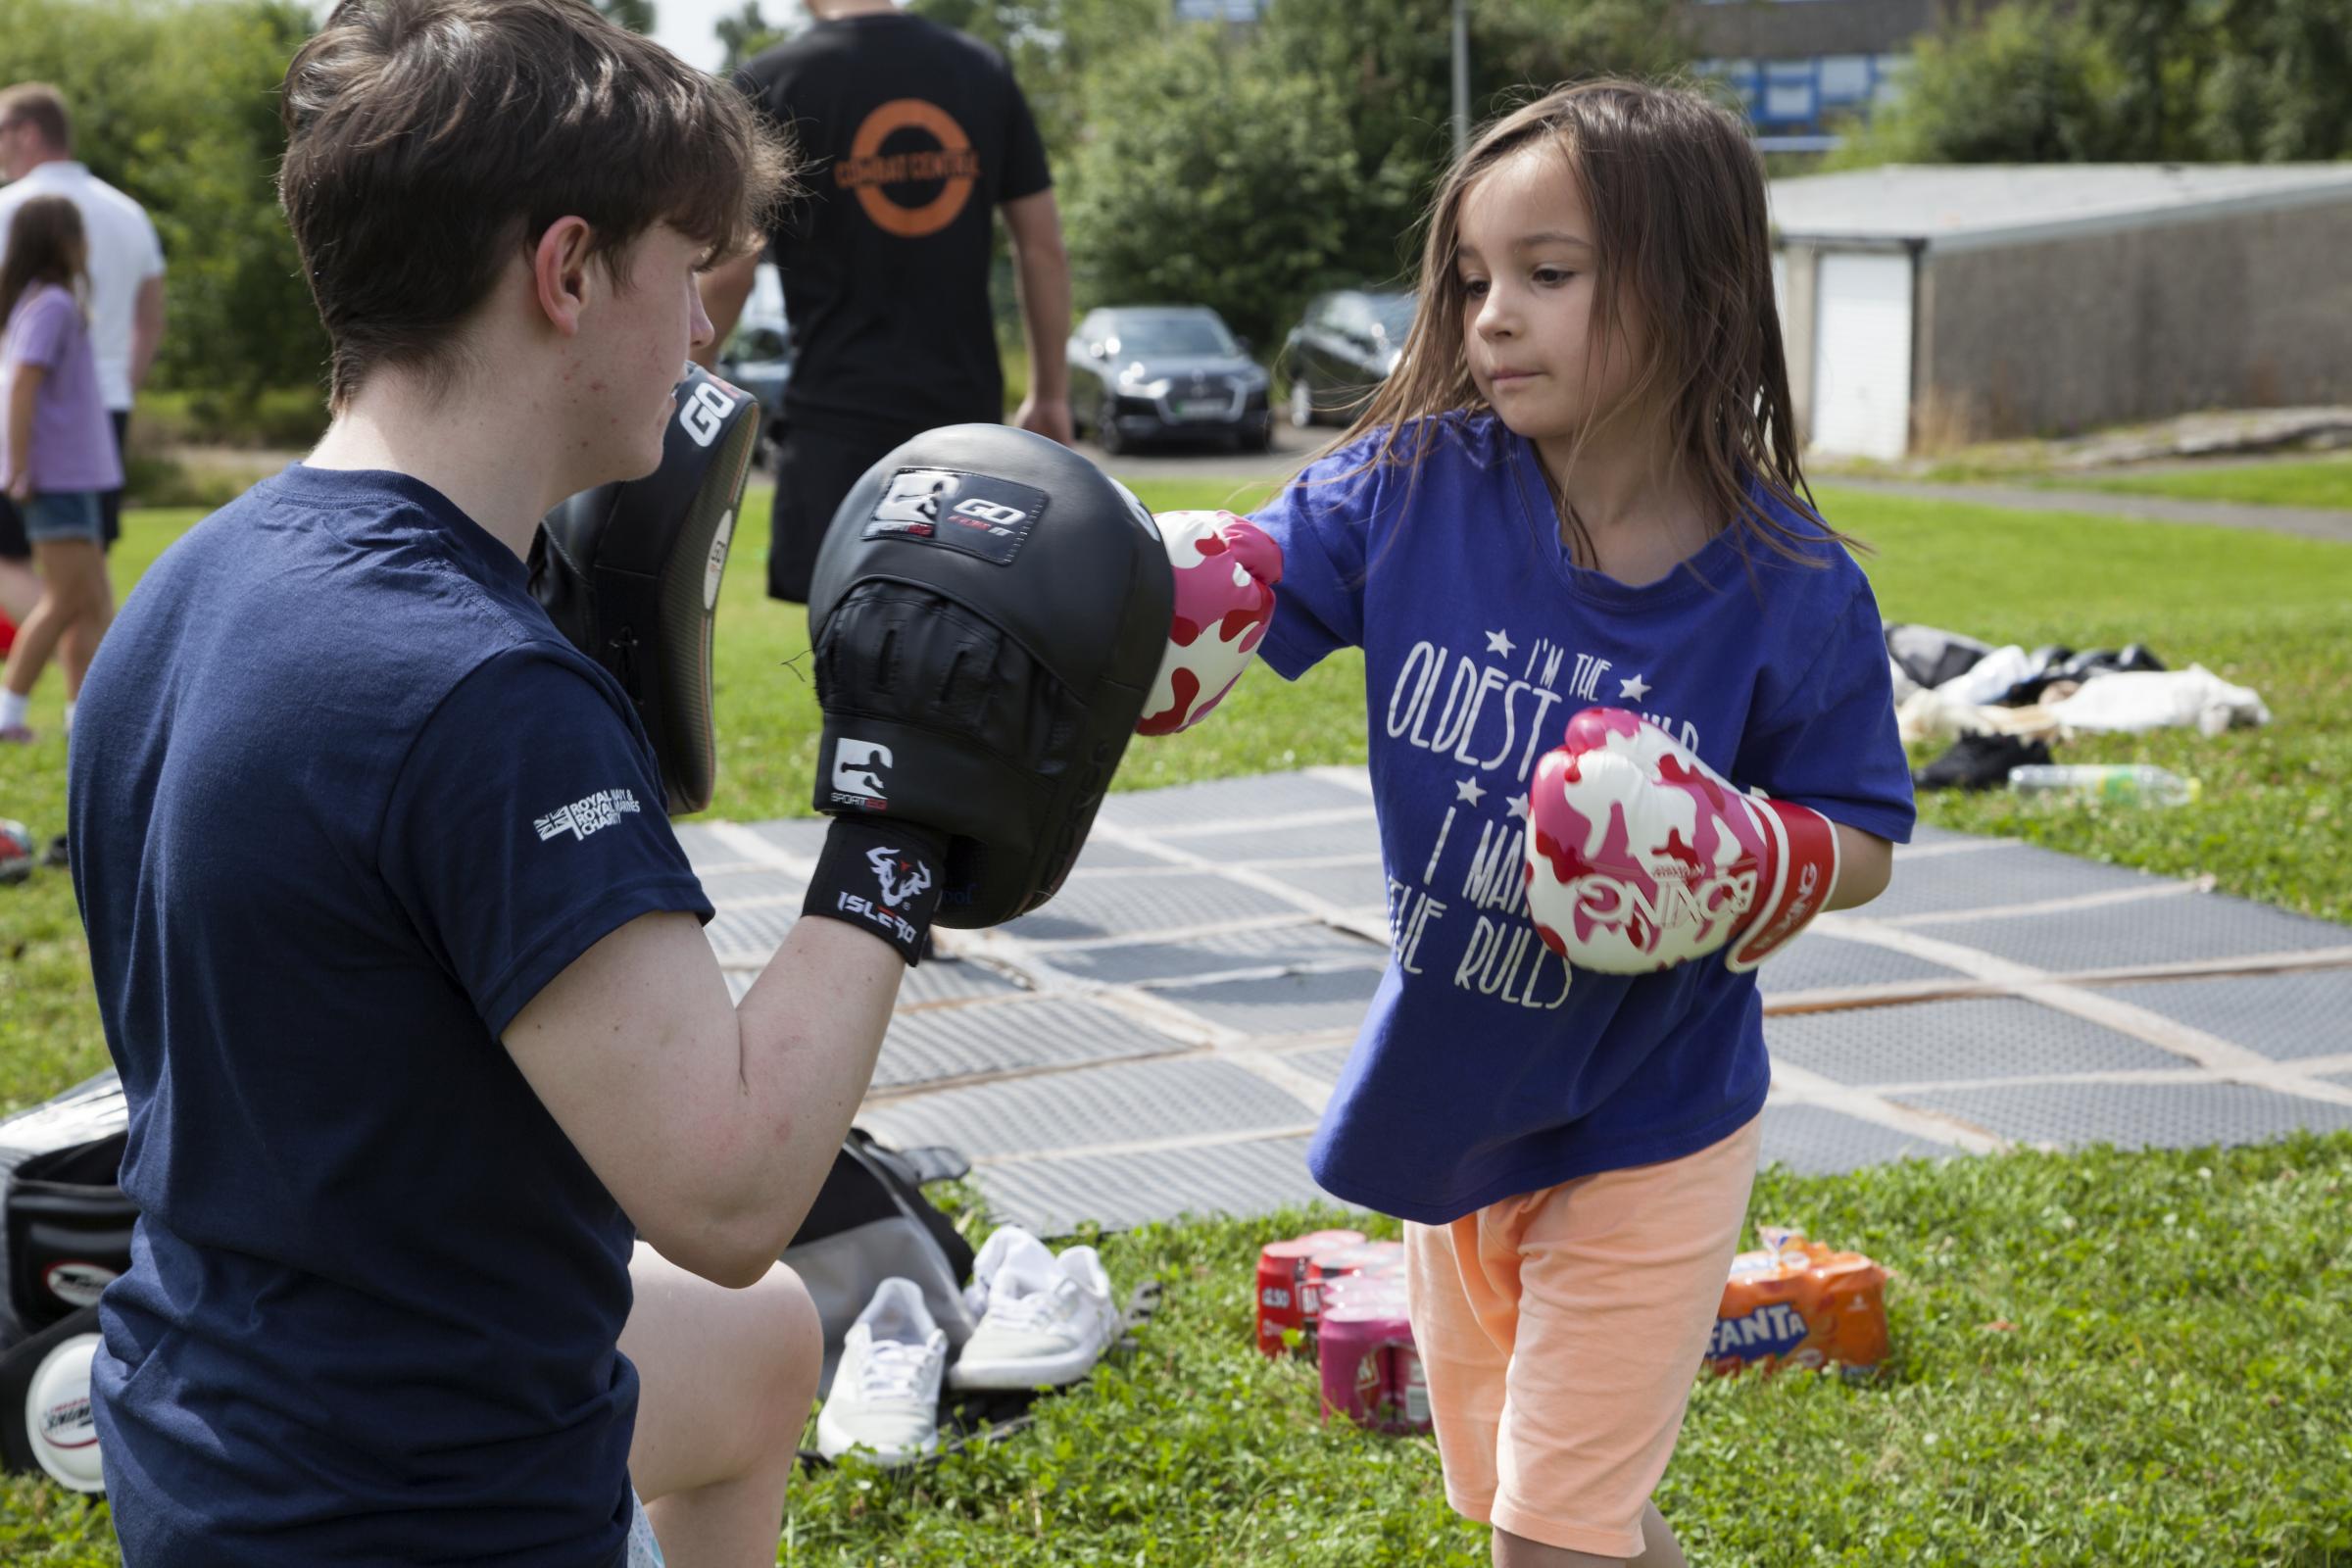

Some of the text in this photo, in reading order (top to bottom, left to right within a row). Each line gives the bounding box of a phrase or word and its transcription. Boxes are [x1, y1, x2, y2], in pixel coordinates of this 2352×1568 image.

[679, 382, 735, 447] GO
[953, 498, 1027, 525] GO
[1525, 637, 1612, 702] I'M THE
[1387, 640, 1562, 782] OLDEST
[569, 790, 612, 815] ROYAL
[575, 802, 615, 827] ROYAL
[1423, 806, 1456, 886] I
[837, 891, 916, 944] ISLERO
